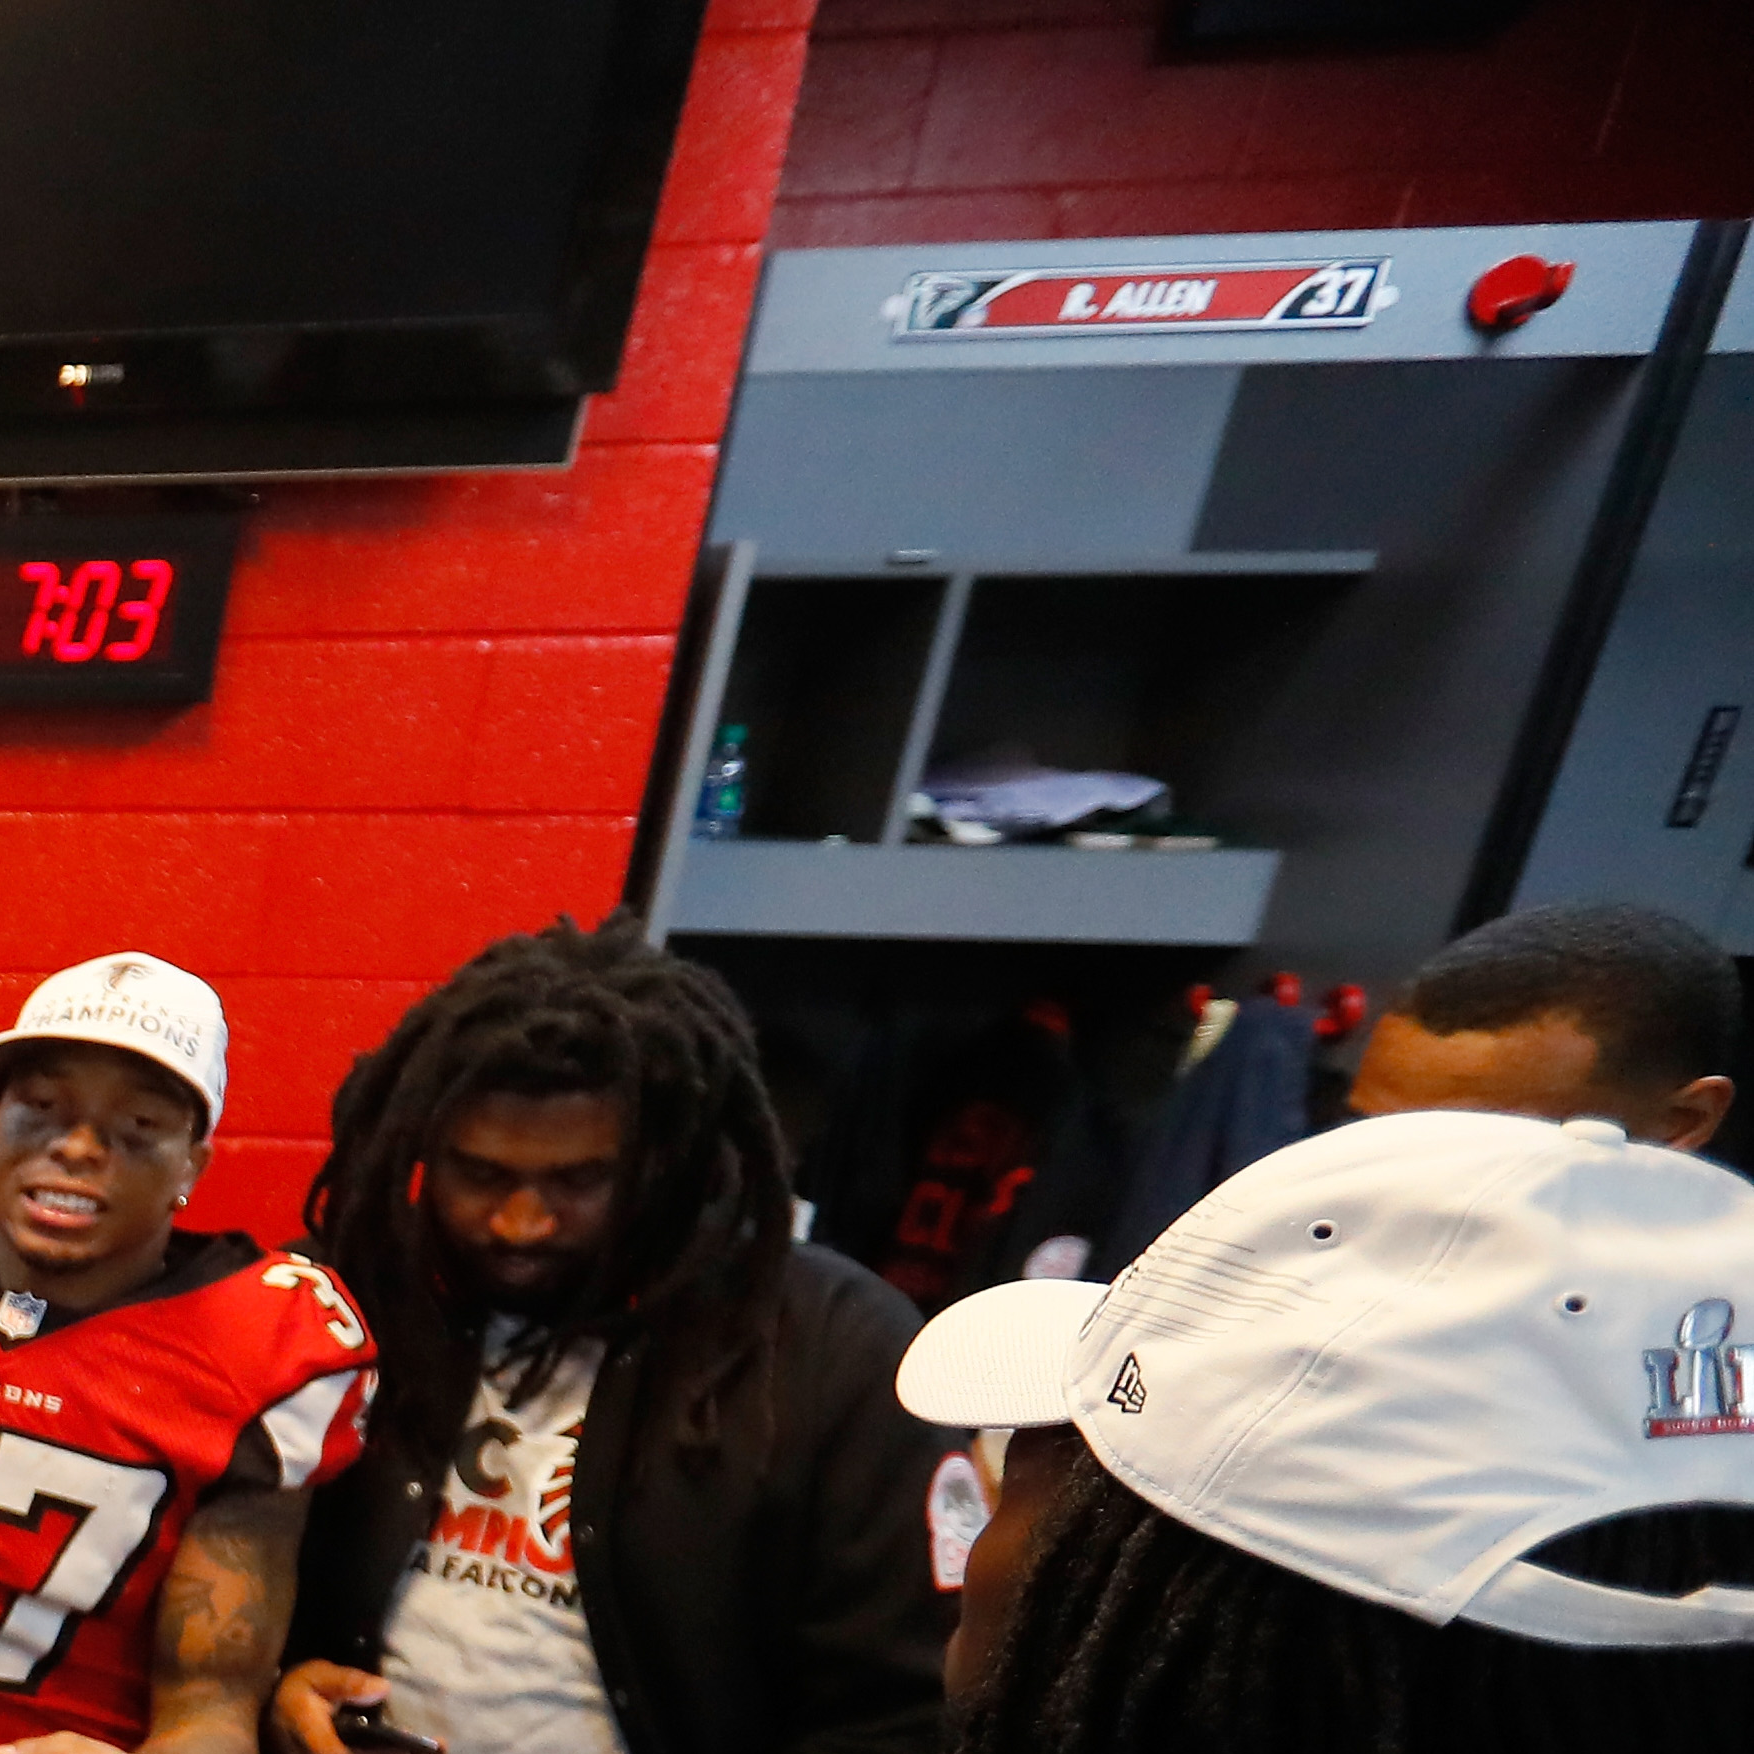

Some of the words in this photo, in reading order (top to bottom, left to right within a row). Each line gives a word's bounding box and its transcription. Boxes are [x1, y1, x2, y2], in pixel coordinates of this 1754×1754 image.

[1099, 279, 1218, 319] ALLEN
[1300, 268, 1366, 316] 37
[18, 559, 174, 662] 7:03
